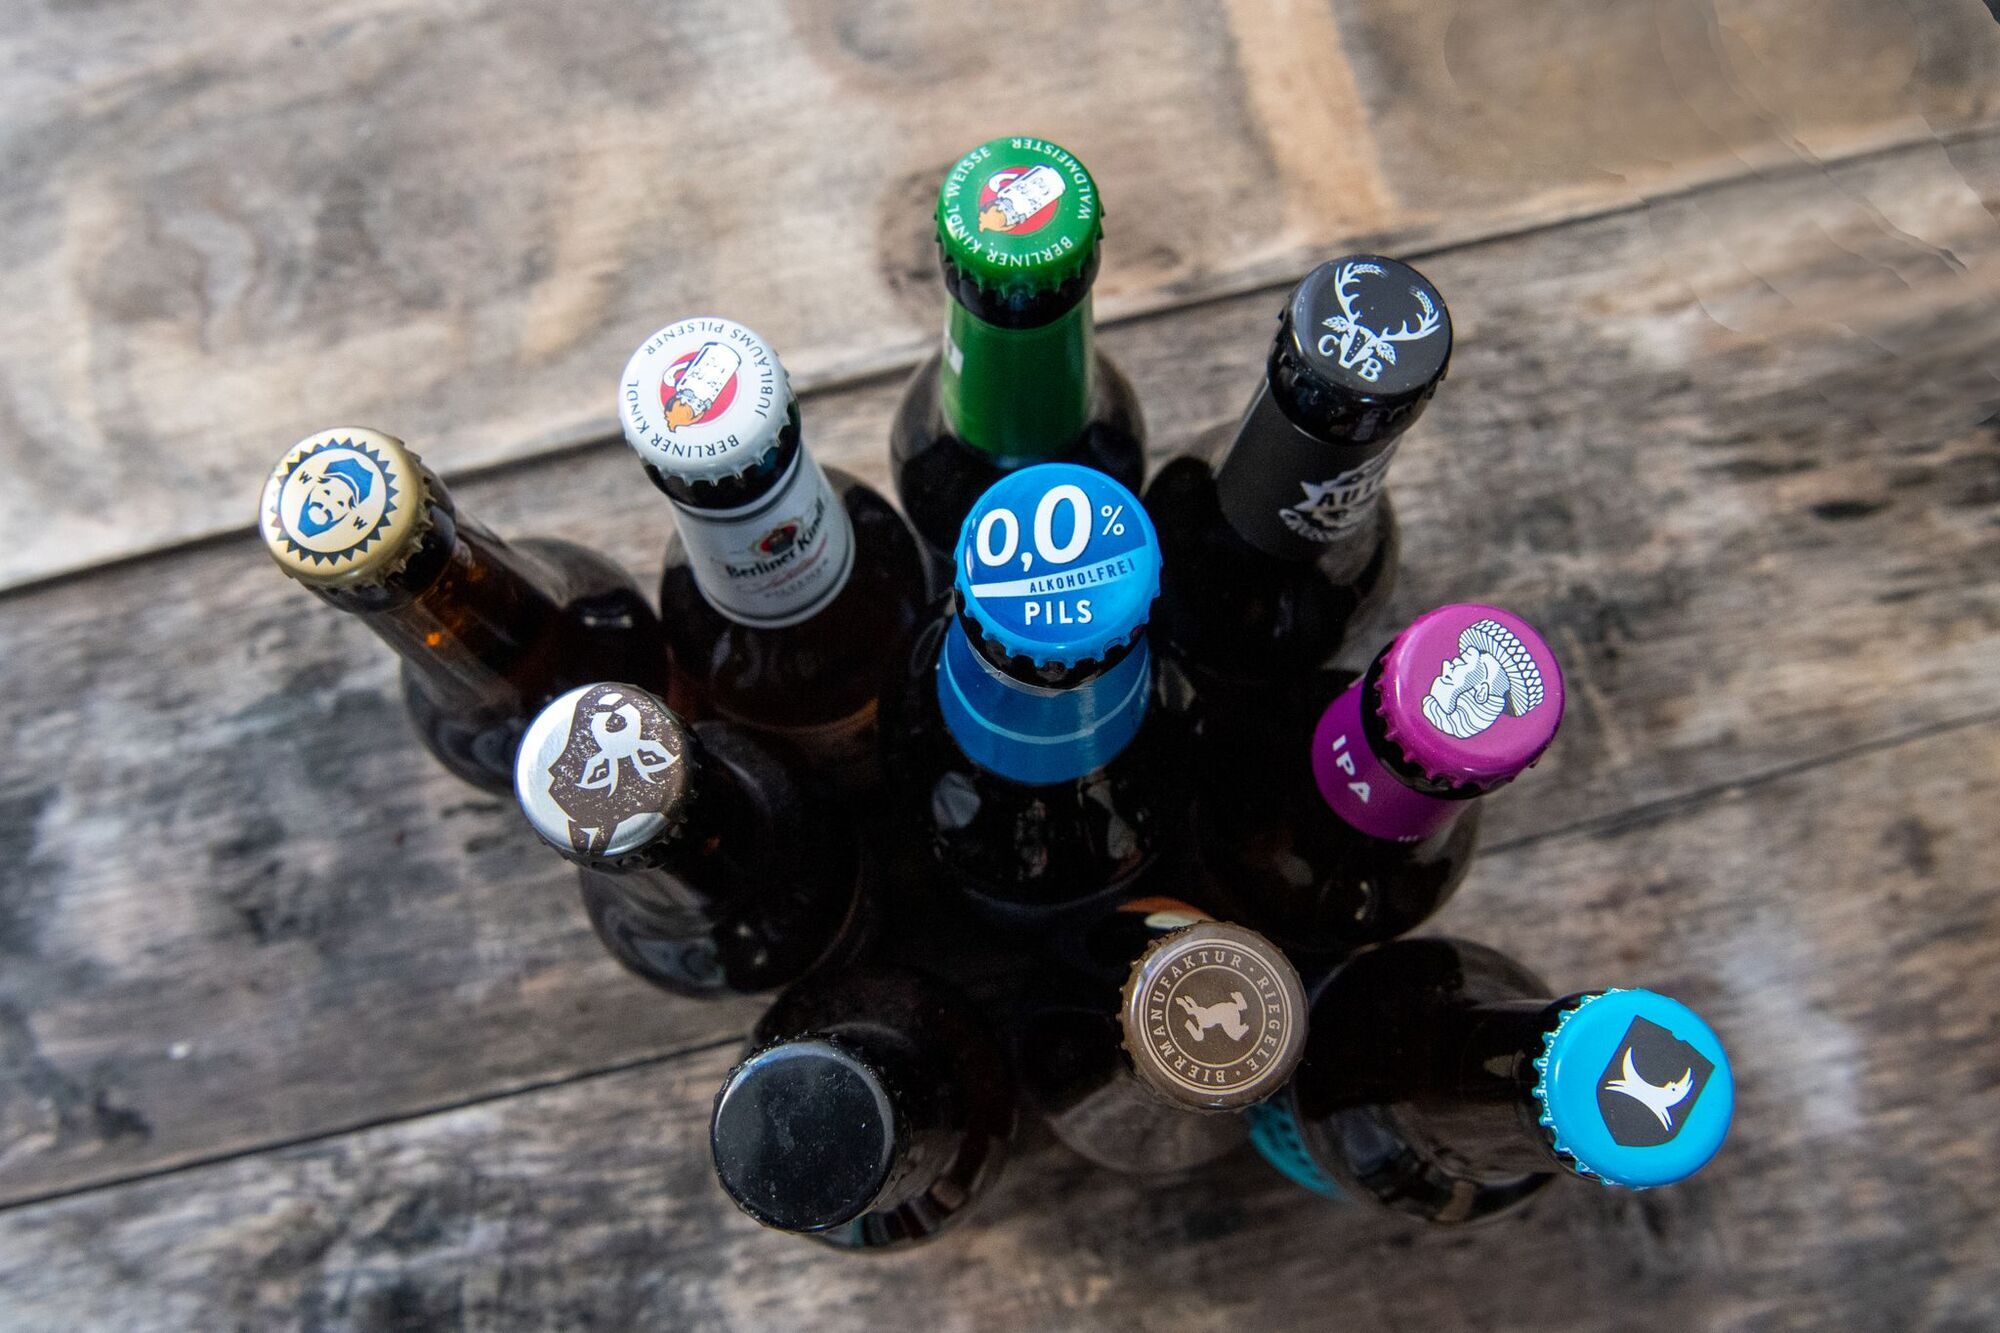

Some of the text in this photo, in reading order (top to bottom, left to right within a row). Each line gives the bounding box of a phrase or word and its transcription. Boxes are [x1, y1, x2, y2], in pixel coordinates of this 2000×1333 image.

[946, 146, 1074, 267] BERLINER KINDL WEISSE
[1011, 138, 1092, 220] WALDMEISTER
[645, 321, 774, 419] JUBILÄUMS PILSENER
[626, 379, 740, 458] BERLINER KINDL
[726, 550, 796, 579] Berliner
[1030, 558, 1136, 593] ALKOHOLFREI
[1025, 600, 1093, 625] PILS
[1332, 734, 1371, 804] IPA
[1151, 951, 1281, 1083] BIERMANUFAKTUR RIEGELE
